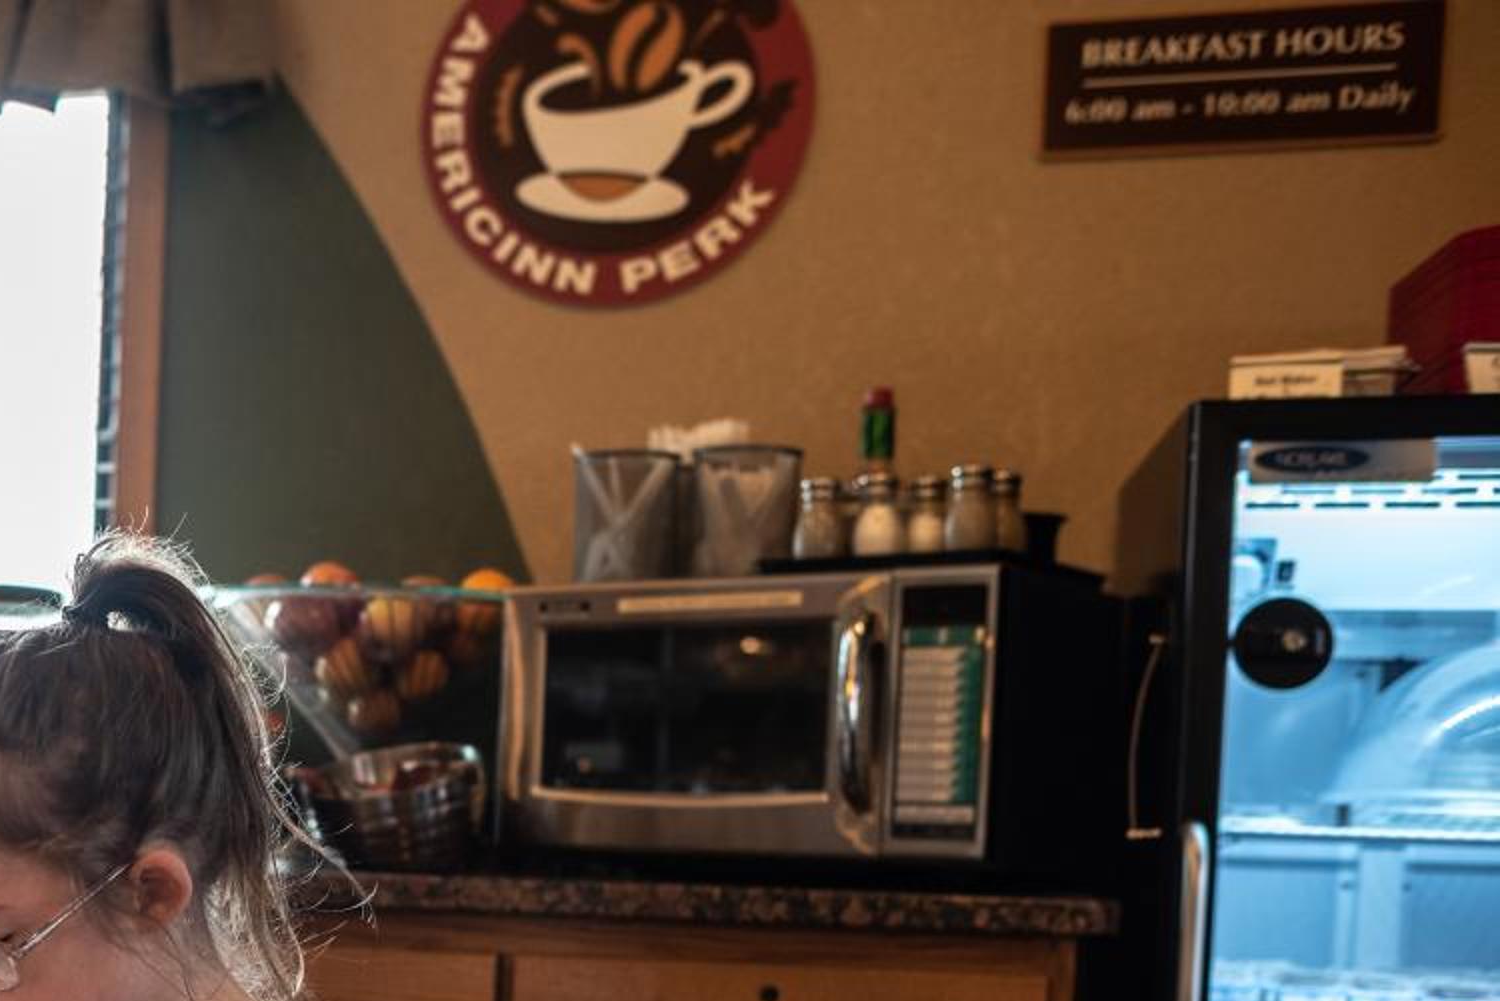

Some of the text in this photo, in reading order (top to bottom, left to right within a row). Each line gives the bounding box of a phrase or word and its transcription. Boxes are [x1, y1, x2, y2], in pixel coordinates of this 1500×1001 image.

[1080, 22, 1405, 70] BREAKFAST HOURS
[1064, 96, 1129, 125] 6:00
[1130, 100, 1177, 121] am
[1203, 90, 1281, 119] 10:00
[1285, 91, 1332, 113] am
[1337, 80, 1415, 116] Daily
[431, 15, 775, 296] AMERICINN PERK
